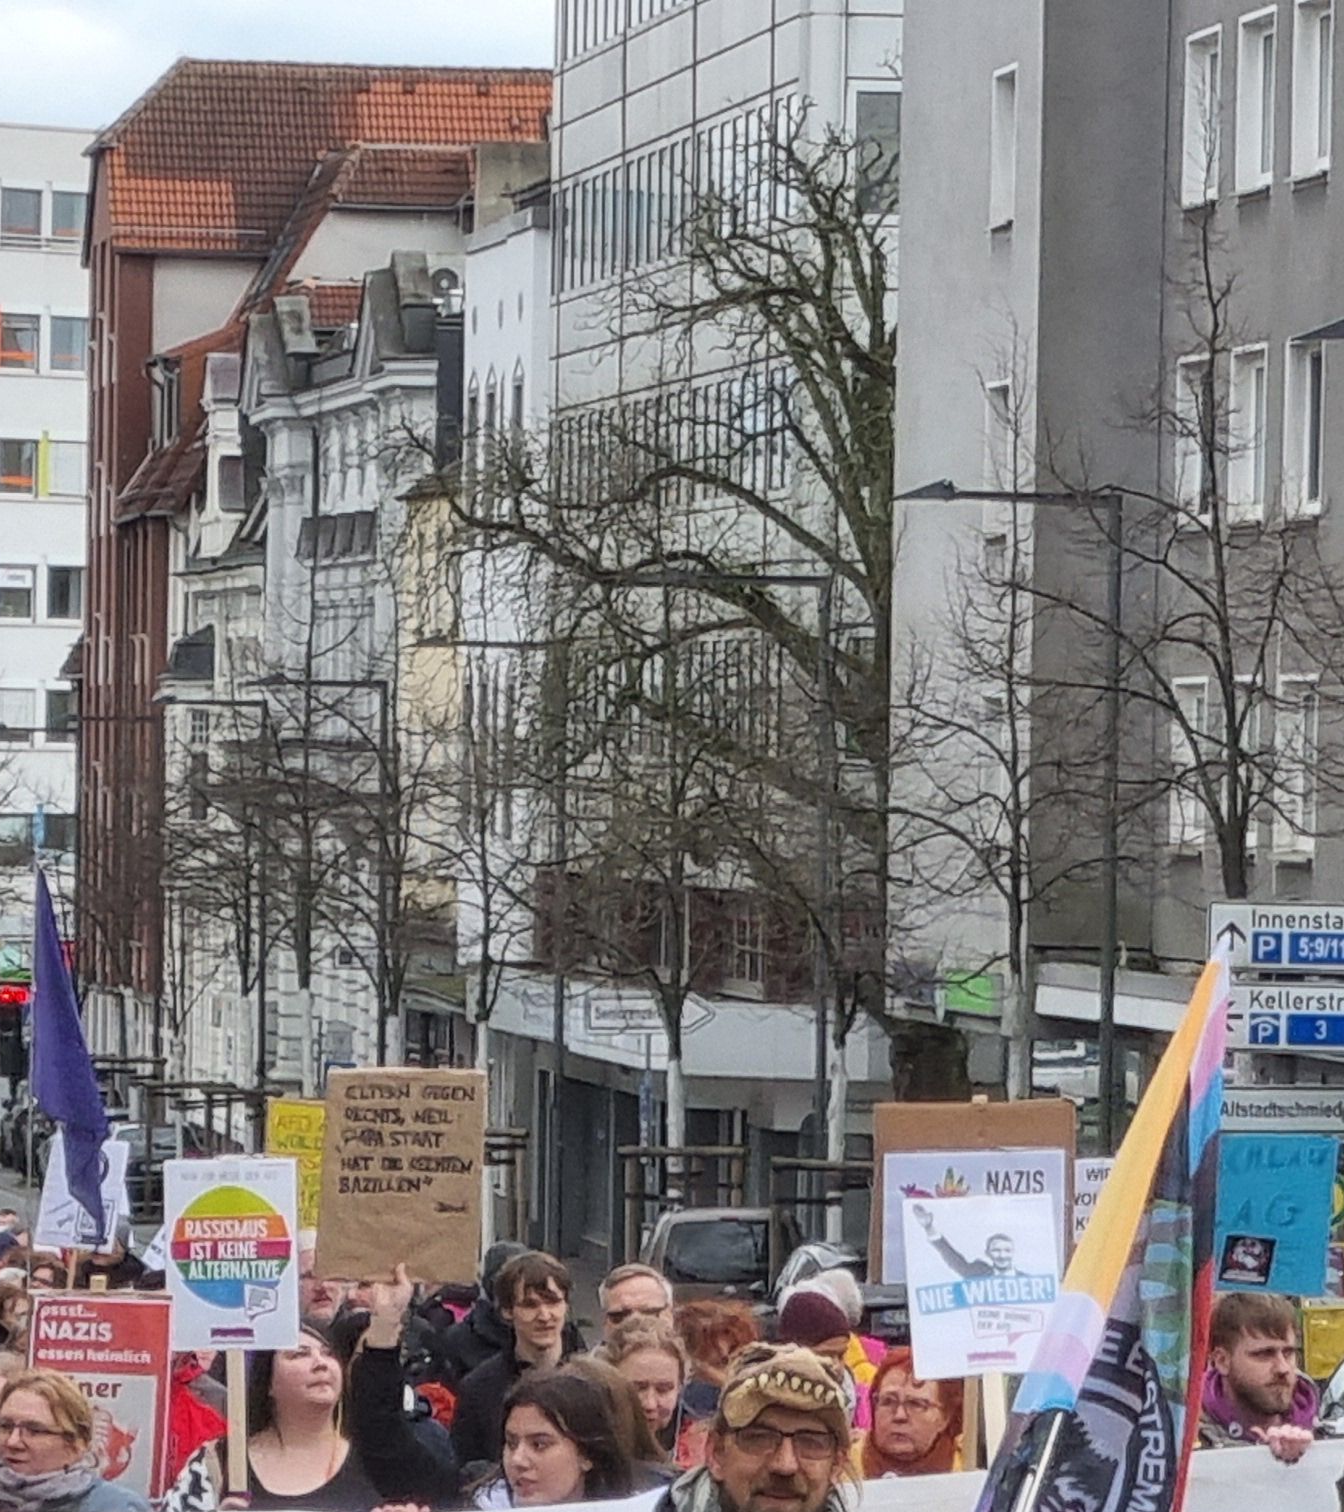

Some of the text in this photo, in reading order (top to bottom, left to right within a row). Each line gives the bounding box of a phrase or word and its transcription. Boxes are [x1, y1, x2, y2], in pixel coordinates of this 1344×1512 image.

[1258, 936, 1276, 959] P
[1313, 1022, 1327, 1041] 3
[421, 1085, 476, 1101] GEGEN
[986, 1169, 1045, 1194] NAZIS
[185, 1219, 268, 1239] RASSISMUS
[189, 1240, 258, 1260] IST KEINE
[188, 1261, 282, 1280] ALTERNATIVE
[918, 1276, 1054, 1313] NIE WIEDER!
[38, 1320, 113, 1343] NAZIS
[37, 1347, 152, 1364] essen heimlich
